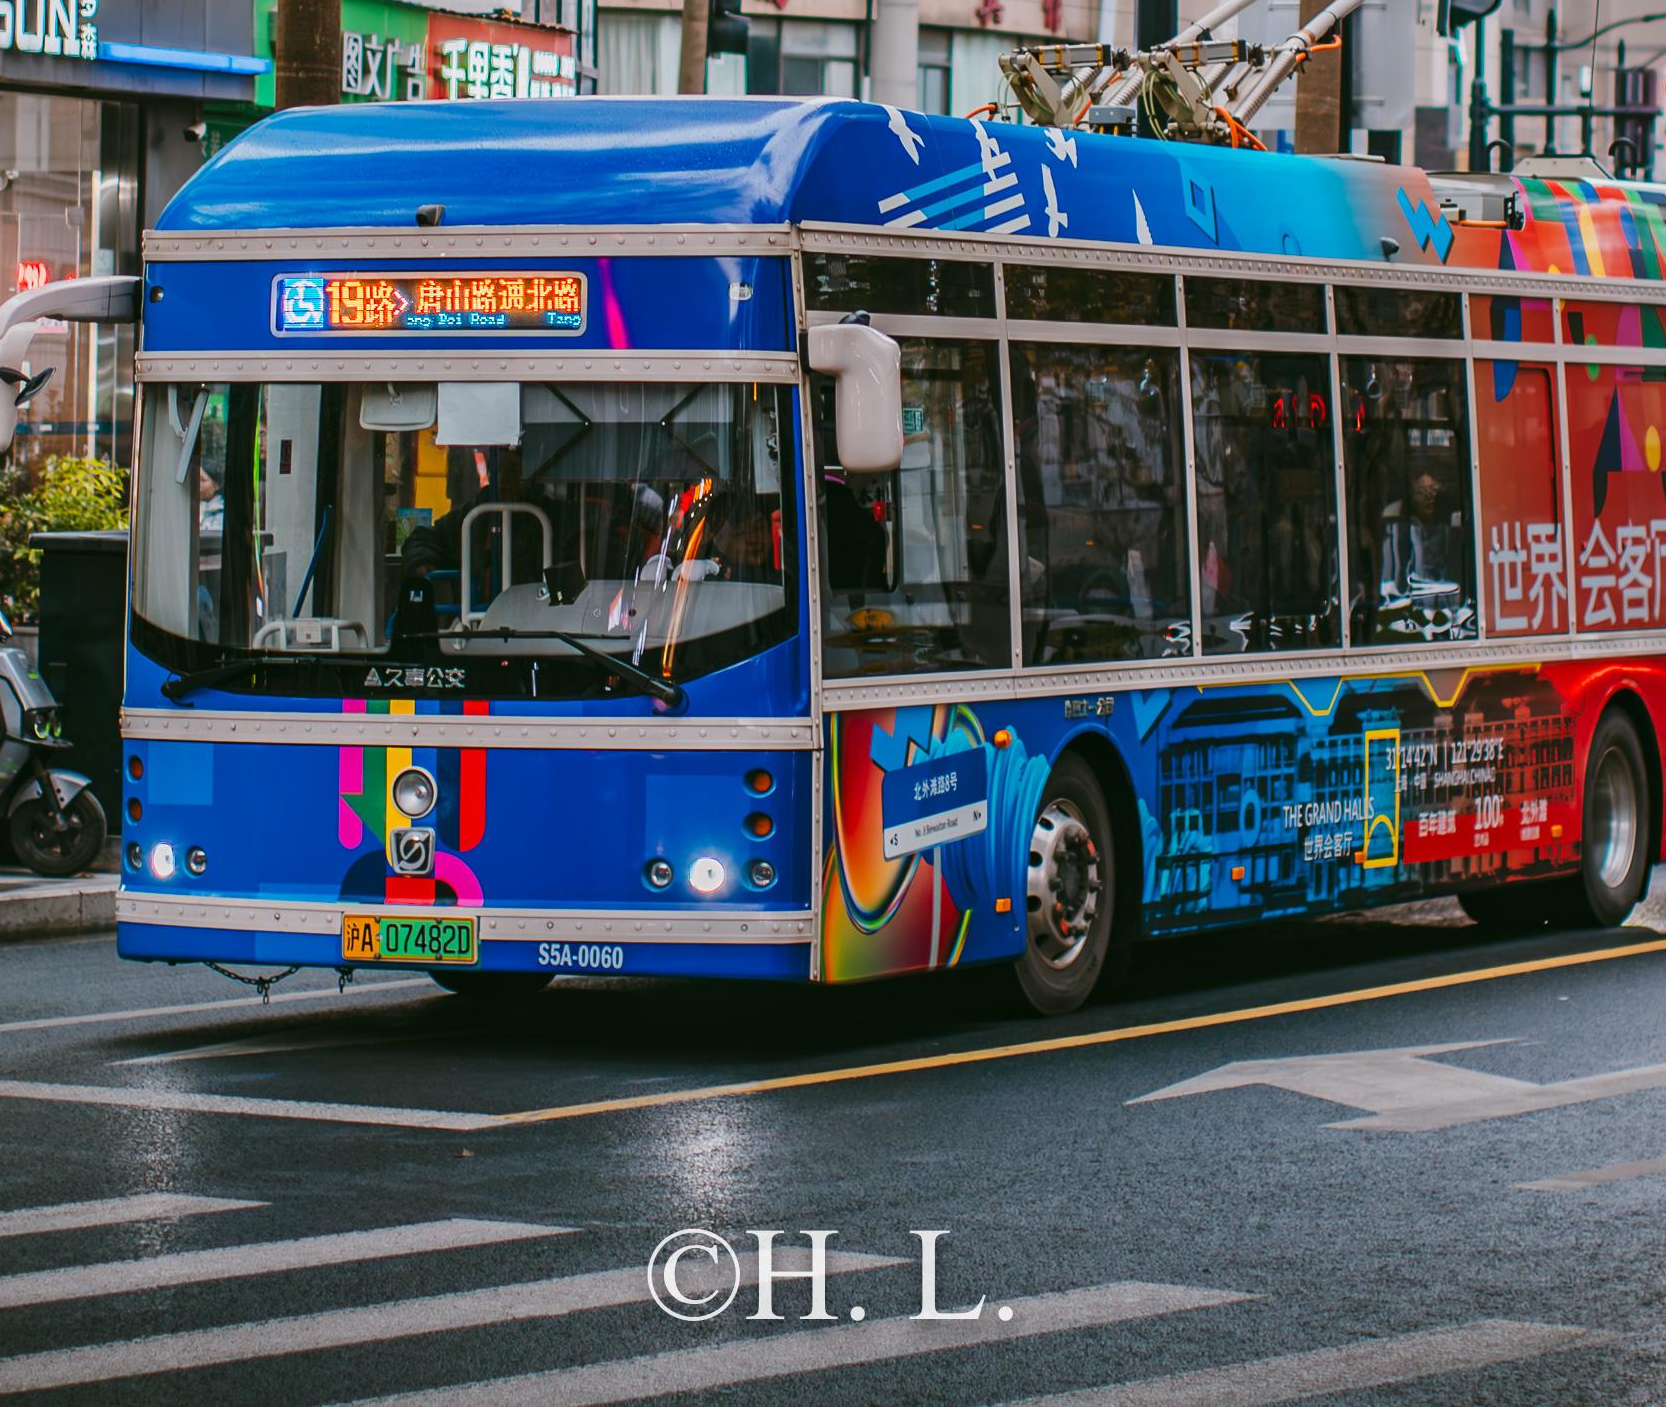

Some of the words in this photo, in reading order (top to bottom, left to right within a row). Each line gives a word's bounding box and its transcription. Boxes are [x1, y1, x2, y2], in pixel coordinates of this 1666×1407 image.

[326, 280, 395, 326] 19路
[1283, 804, 1303, 828] THE
[1304, 800, 1342, 827] GRAND
[1344, 796, 1375, 822] HALLS
[538, 943, 624, 969] S5A-0060
